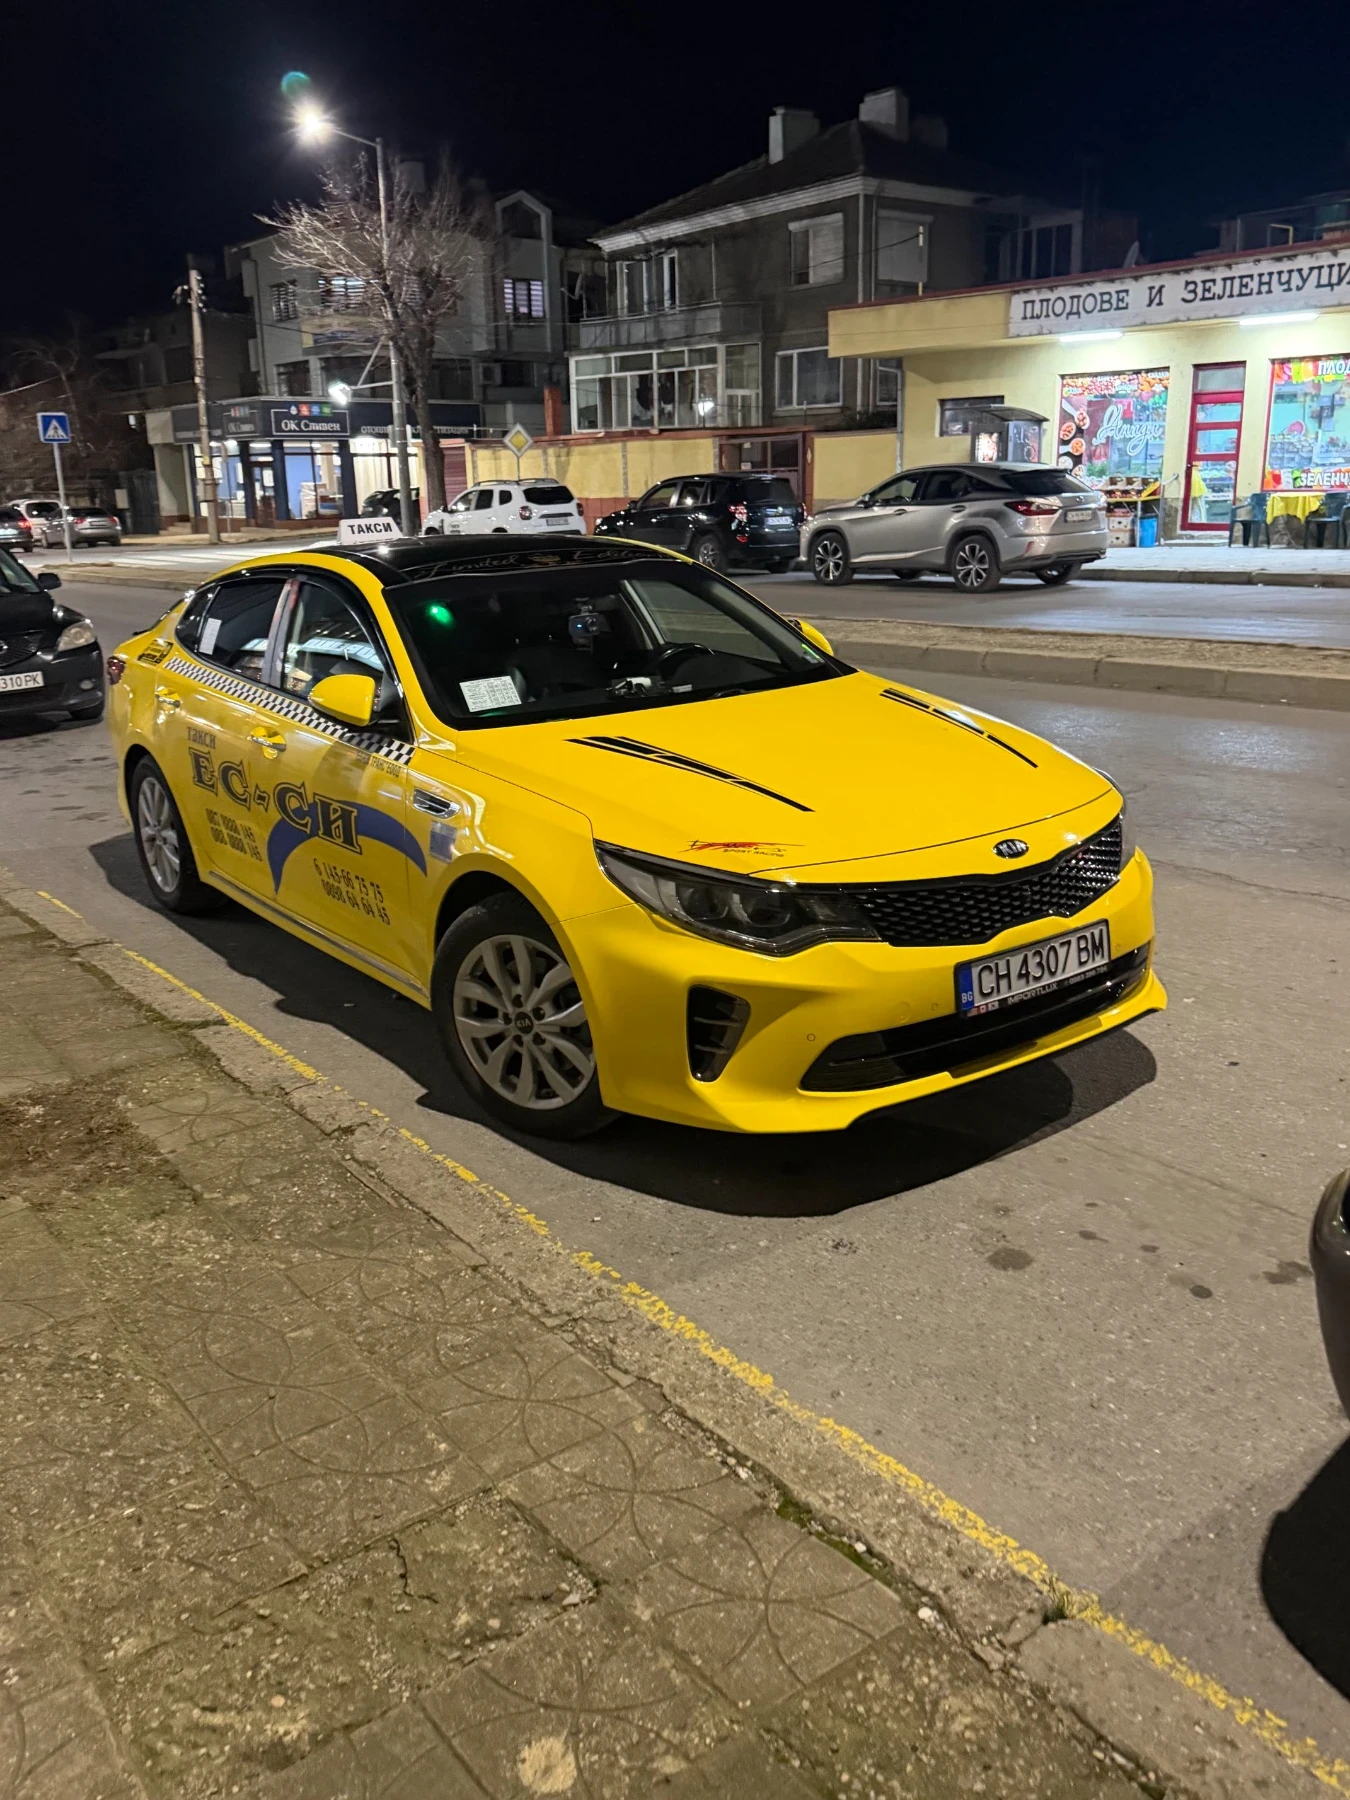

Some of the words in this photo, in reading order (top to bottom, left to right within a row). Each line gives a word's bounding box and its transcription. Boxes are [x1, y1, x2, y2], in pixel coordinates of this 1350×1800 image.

[1021, 288, 1130, 321] ПЛОДОВЕ
[1146, 285, 1165, 308] И
[1181, 262, 1350, 304] ЗЕЛЕНЧУЦИ
[281, 419, 299, 431] ОК
[1299, 470, 1350, 488] ЗЕЛЕНЧ
[347, 522, 393, 535] ТАКСИ
[24, 673, 40, 686] PK
[997, 840, 1027, 856] KIA
[355, 874, 369, 896] 75
[369, 881, 384, 904] 75
[978, 958, 1013, 998] CH
[1017, 939, 1073, 986] 4307
[1077, 928, 1106, 967] BM
[961, 992, 974, 1004] BG
[1007, 982, 1058, 1005] IMPORTLUX
[516, 1018, 532, 1028] KIA
